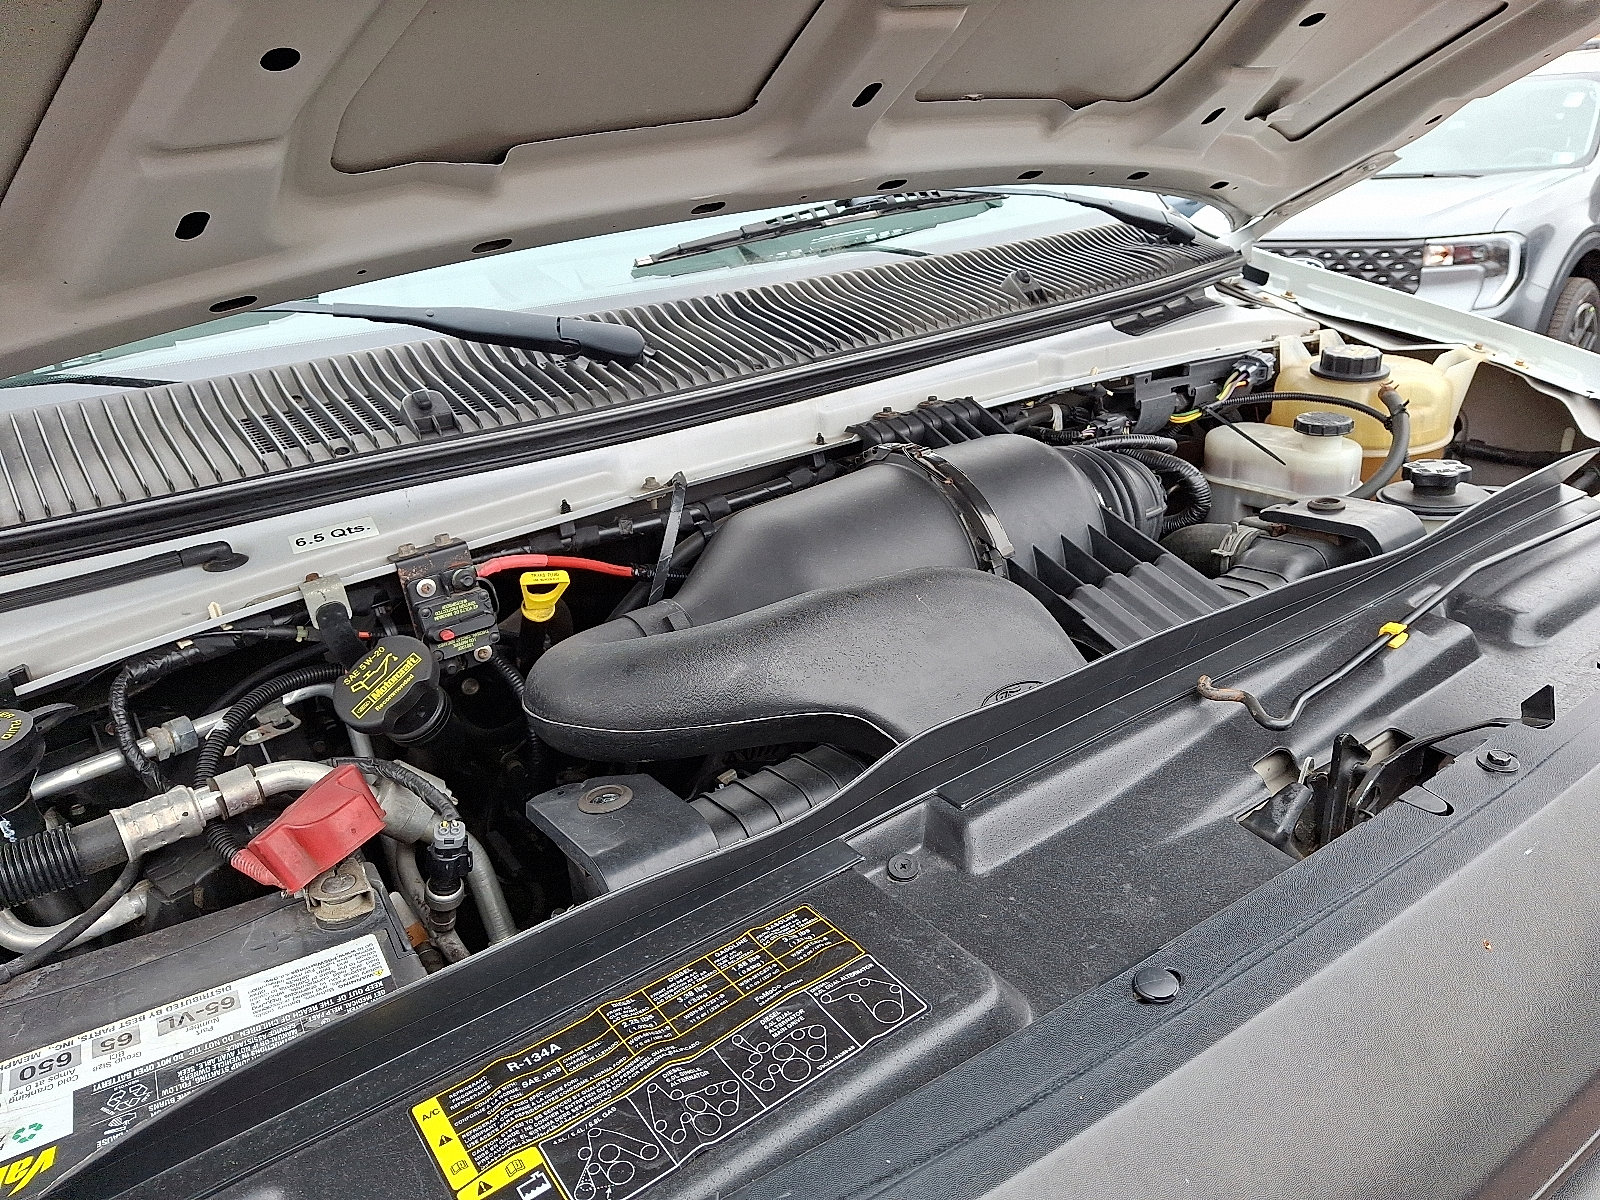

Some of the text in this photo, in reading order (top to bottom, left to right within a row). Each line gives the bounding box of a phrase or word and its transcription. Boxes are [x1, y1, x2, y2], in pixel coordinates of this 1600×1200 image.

[296, 526, 370, 546] 6.5 Qts.
[343, 646, 385, 685] SAE 5W-20
[370, 657, 418, 700] Motorcraft
[374, 674, 414, 711] Recommended
[714, 936, 748, 957] GASOLINE
[840, 963, 874, 981] ALTERNATOR
[166, 985, 232, 1012] DISTRIBUTED
[754, 984, 781, 1001] FoMoCo
[149, 1009, 162, 1018] BY
[159, 996, 235, 1028] 65-VL
[760, 1010, 781, 1024] DIESEL
[768, 1008, 805, 1034] ALTERNATOR
[775, 1010, 793, 1022] DUAL
[118, 1014, 146, 1029] BEST
[185, 1016, 220, 1032] Number
[771, 1015, 805, 1038] MAIN DRIVE
[77, 1025, 115, 1041] PARTS,
[93, 980, 383, 1091] KEEP OUT OF THE REACH OF CHILDREN. DO NOT TIP. DO NOT OPEN BATTERY!
[100, 1032, 132, 1052] 65
[20, 1052, 72, 1080] 650
[113, 1051, 142, 1064] Group
[212, 1056, 241, 1070] VEHICLE
[506, 1043, 561, 1072] R-134A
[48, 1068, 76, 1082] Amps
[521, 1076, 541, 1088] SAE
[9, 1074, 78, 1104] Cold Cranking
[161, 1080, 192, 1096] FOLLOW
[148, 1097, 175, 1111] BURNS
[420, 1107, 440, 1121] A/C
